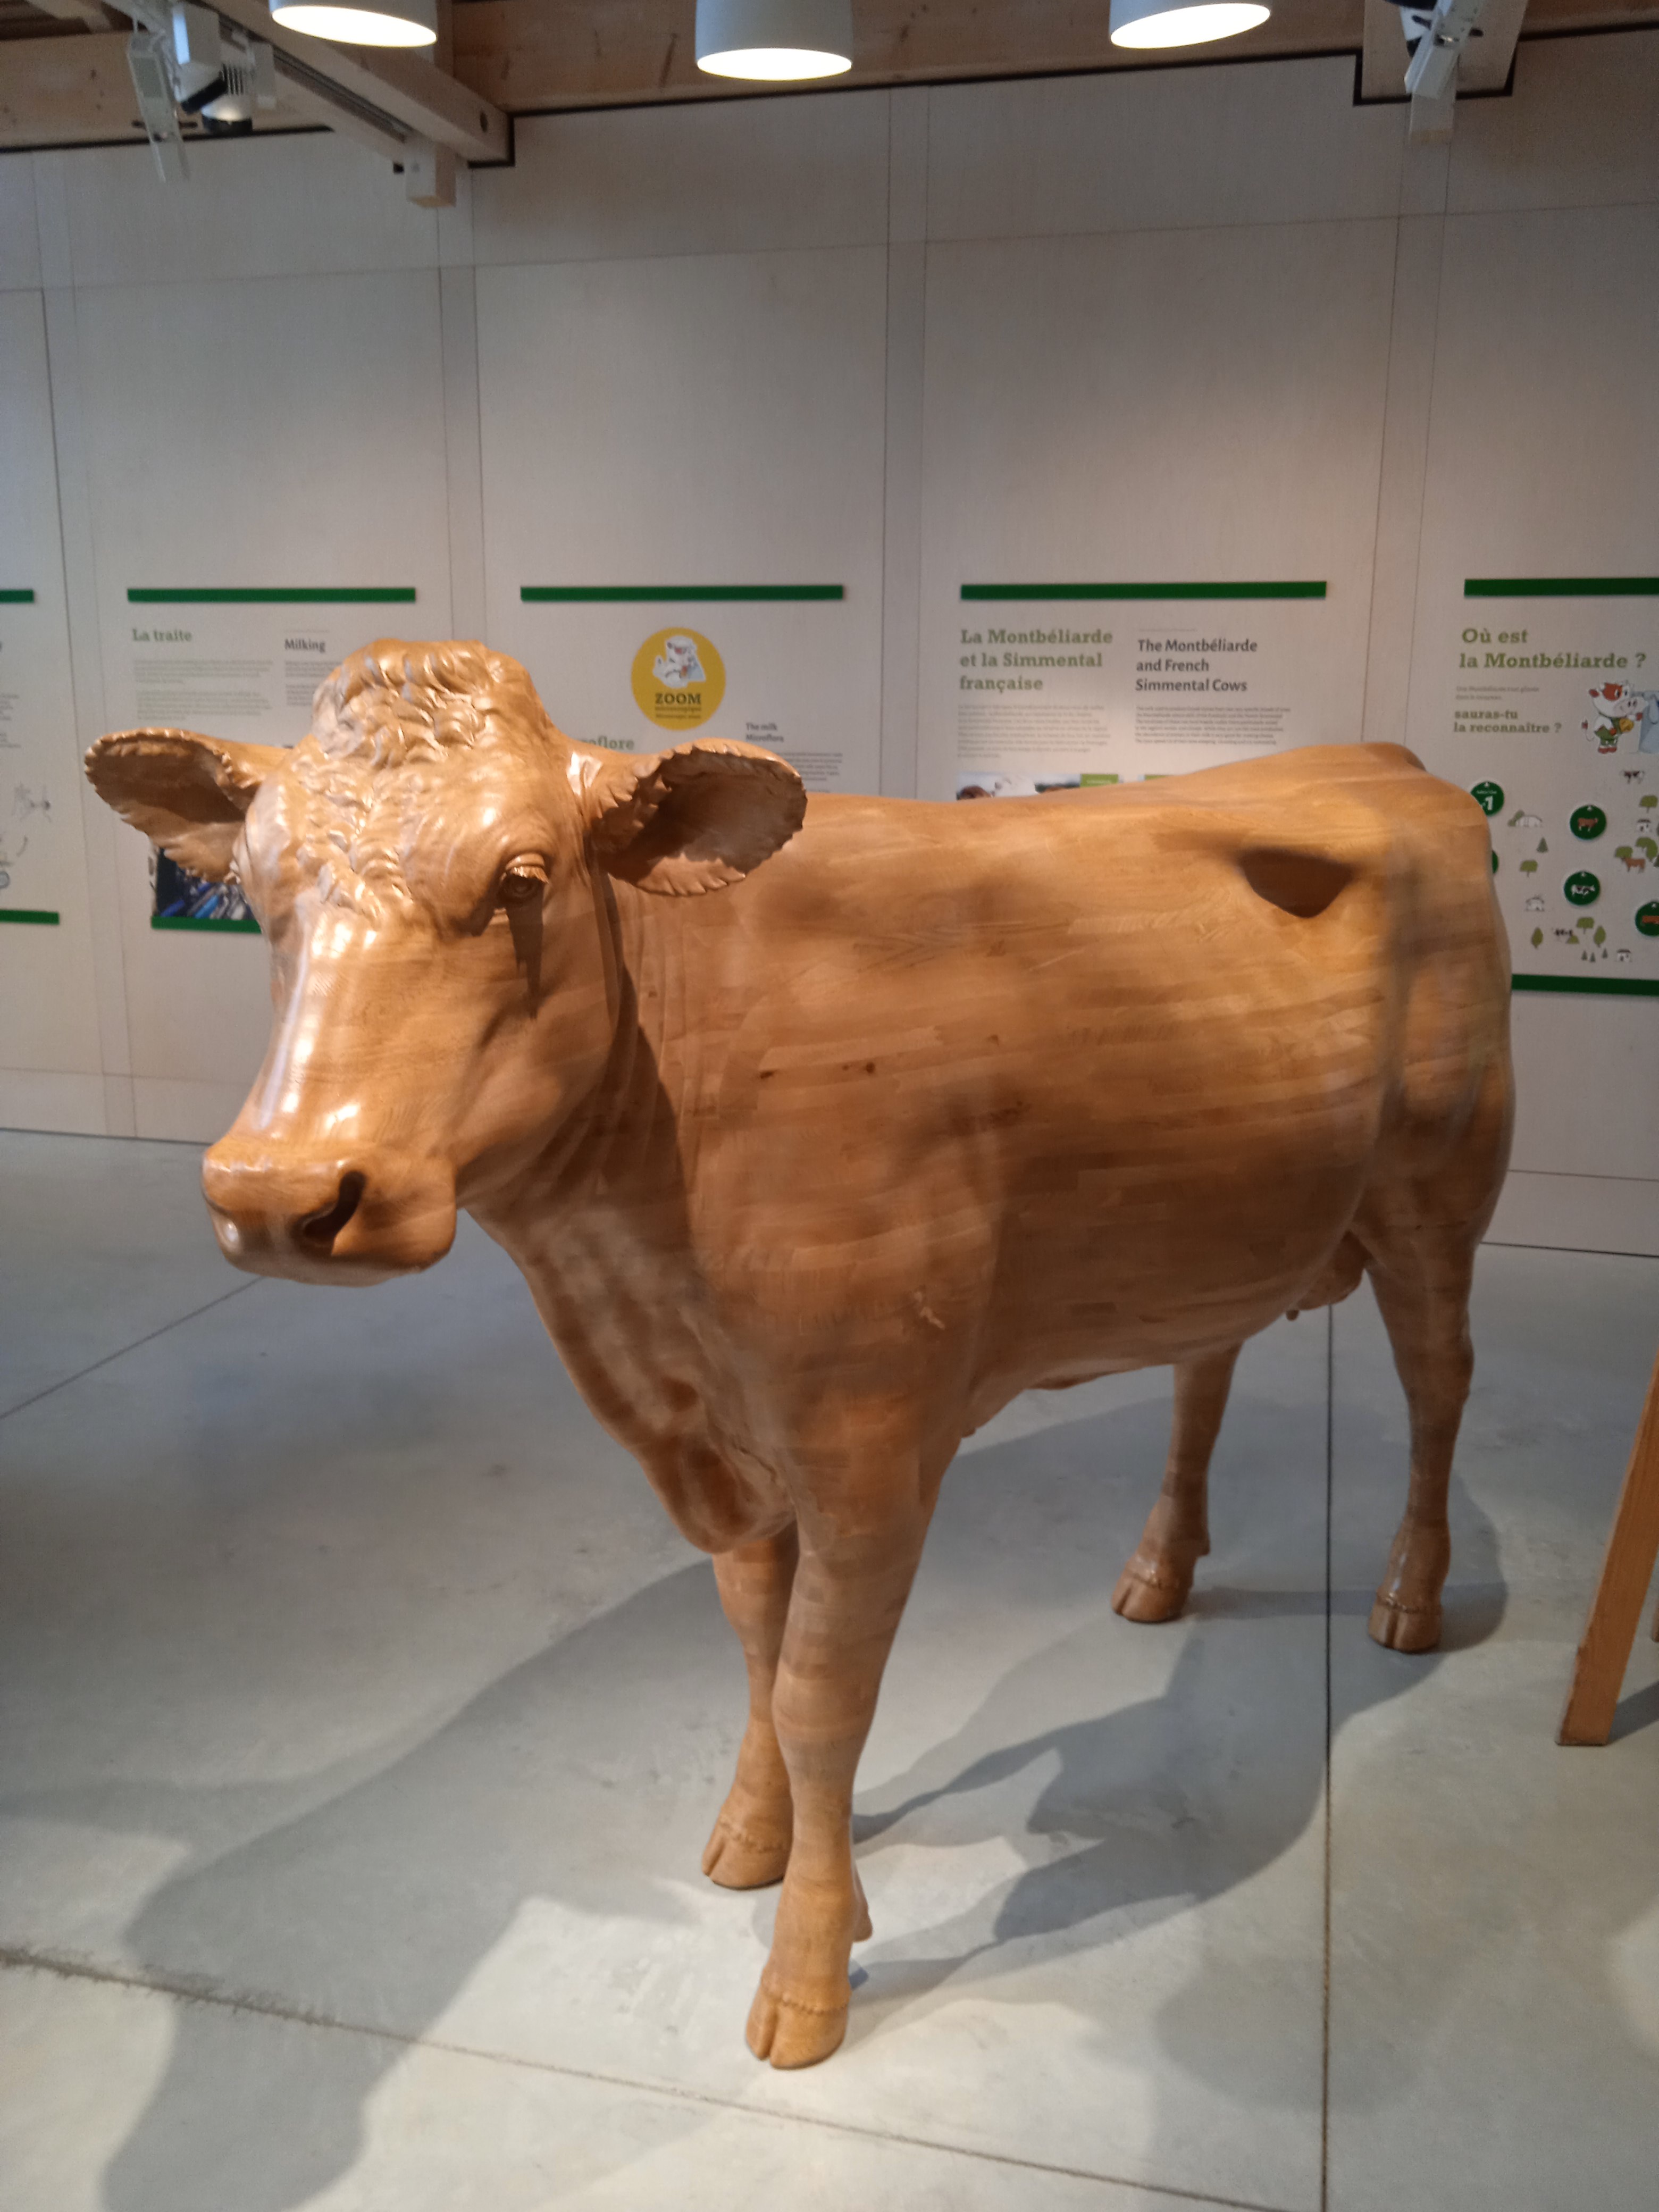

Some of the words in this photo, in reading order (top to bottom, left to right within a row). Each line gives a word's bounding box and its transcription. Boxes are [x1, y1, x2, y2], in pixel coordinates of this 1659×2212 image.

[132, 628, 150, 642] La
[153, 629, 192, 642] traite
[960, 629, 982, 644] La
[987, 628, 1112, 644] Montbéliarde
[1462, 628, 1492, 643] Où
[1498, 629, 1528, 643] est
[284, 638, 326, 653] Milking
[1138, 639, 1162, 652] The
[1165, 639, 1258, 652] Montbéliarde
[960, 653, 976, 667] et
[982, 652, 998, 667] la
[1003, 652, 1102, 667] Simmental
[1136, 659, 1162, 672] and
[1165, 658, 1210, 672] French
[1459, 653, 1478, 668] la
[1484, 652, 1628, 668] Montbéliarde
[1635, 652, 1646, 668] ?
[960, 675, 1043, 693] française
[1135, 678, 1210, 692] Simmental
[1212, 679, 1248, 692] Cows
[655, 693, 701, 705] ZOOM
[1454, 709, 1518, 719] sauras-tu
[761, 723, 777, 731] milk
[1454, 722, 1466, 733] la
[1470, 722, 1550, 733] reconnaître
[1554, 722, 1562, 733] ?
